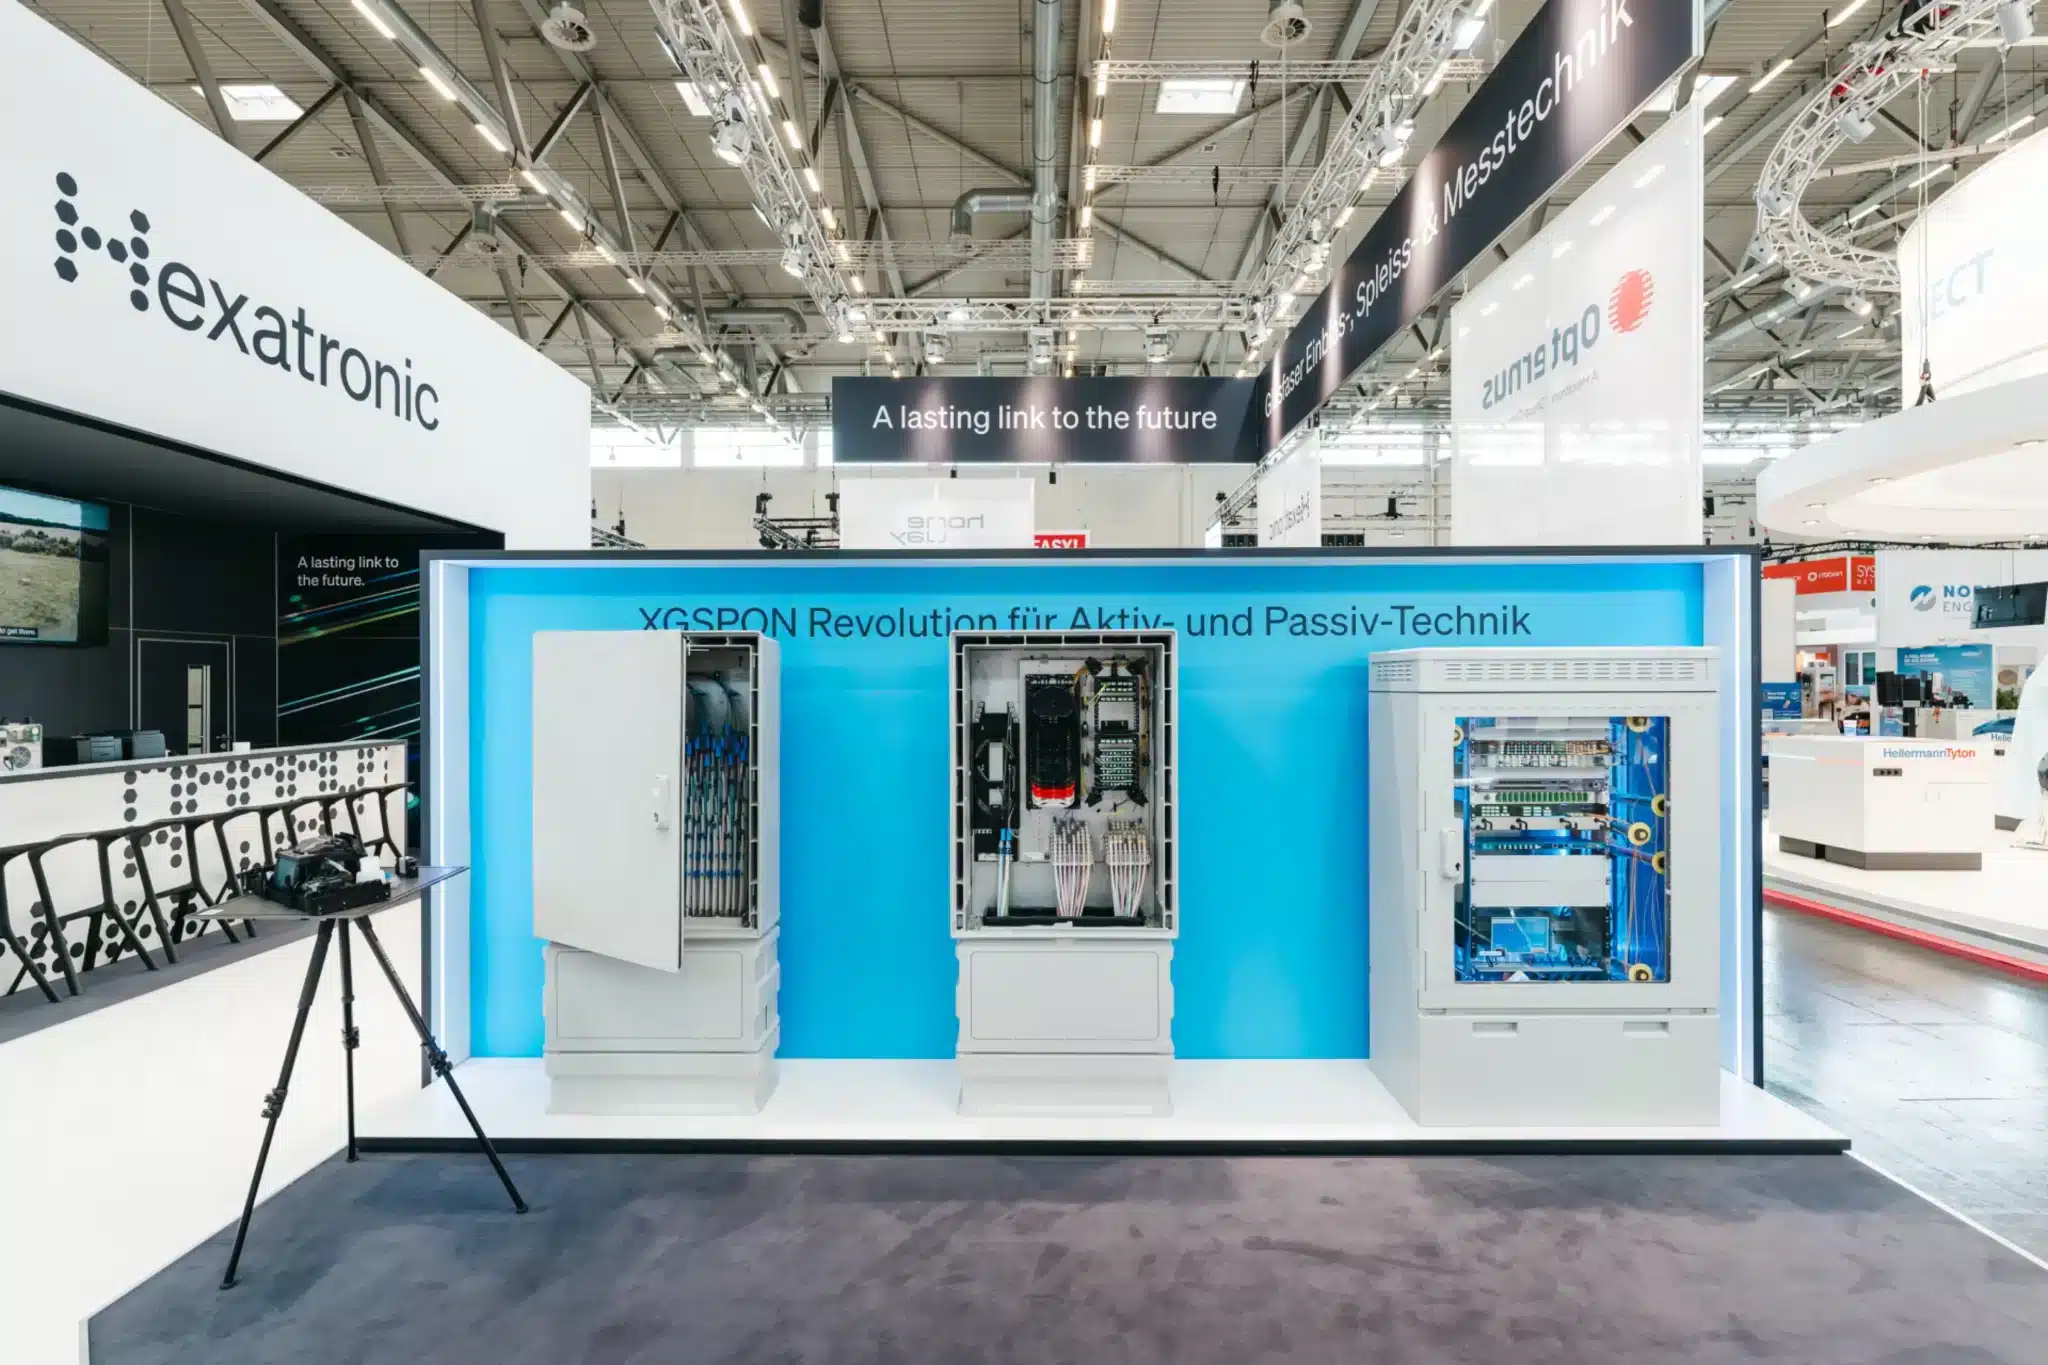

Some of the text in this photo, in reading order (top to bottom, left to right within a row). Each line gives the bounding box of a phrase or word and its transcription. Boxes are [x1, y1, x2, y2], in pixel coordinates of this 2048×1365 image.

[1264, 357, 1305, 419] Gsfaser
[1306, 311, 1355, 376] Einbs-,
[1356, 237, 1418, 318] Spleiss-
[1443, 0, 1634, 225] Messtechnik
[54, 171, 440, 431] Hexatronic
[872, 404, 1217, 435] A lasting link to the future
[297, 555, 399, 571] A lasting link to
[297, 573, 366, 587] the future.
[638, 605, 1532, 638] XGSPON Revolution für Aktiv- und Passiv-Technik
[1883, 748, 1976, 760] HellermannTyton
